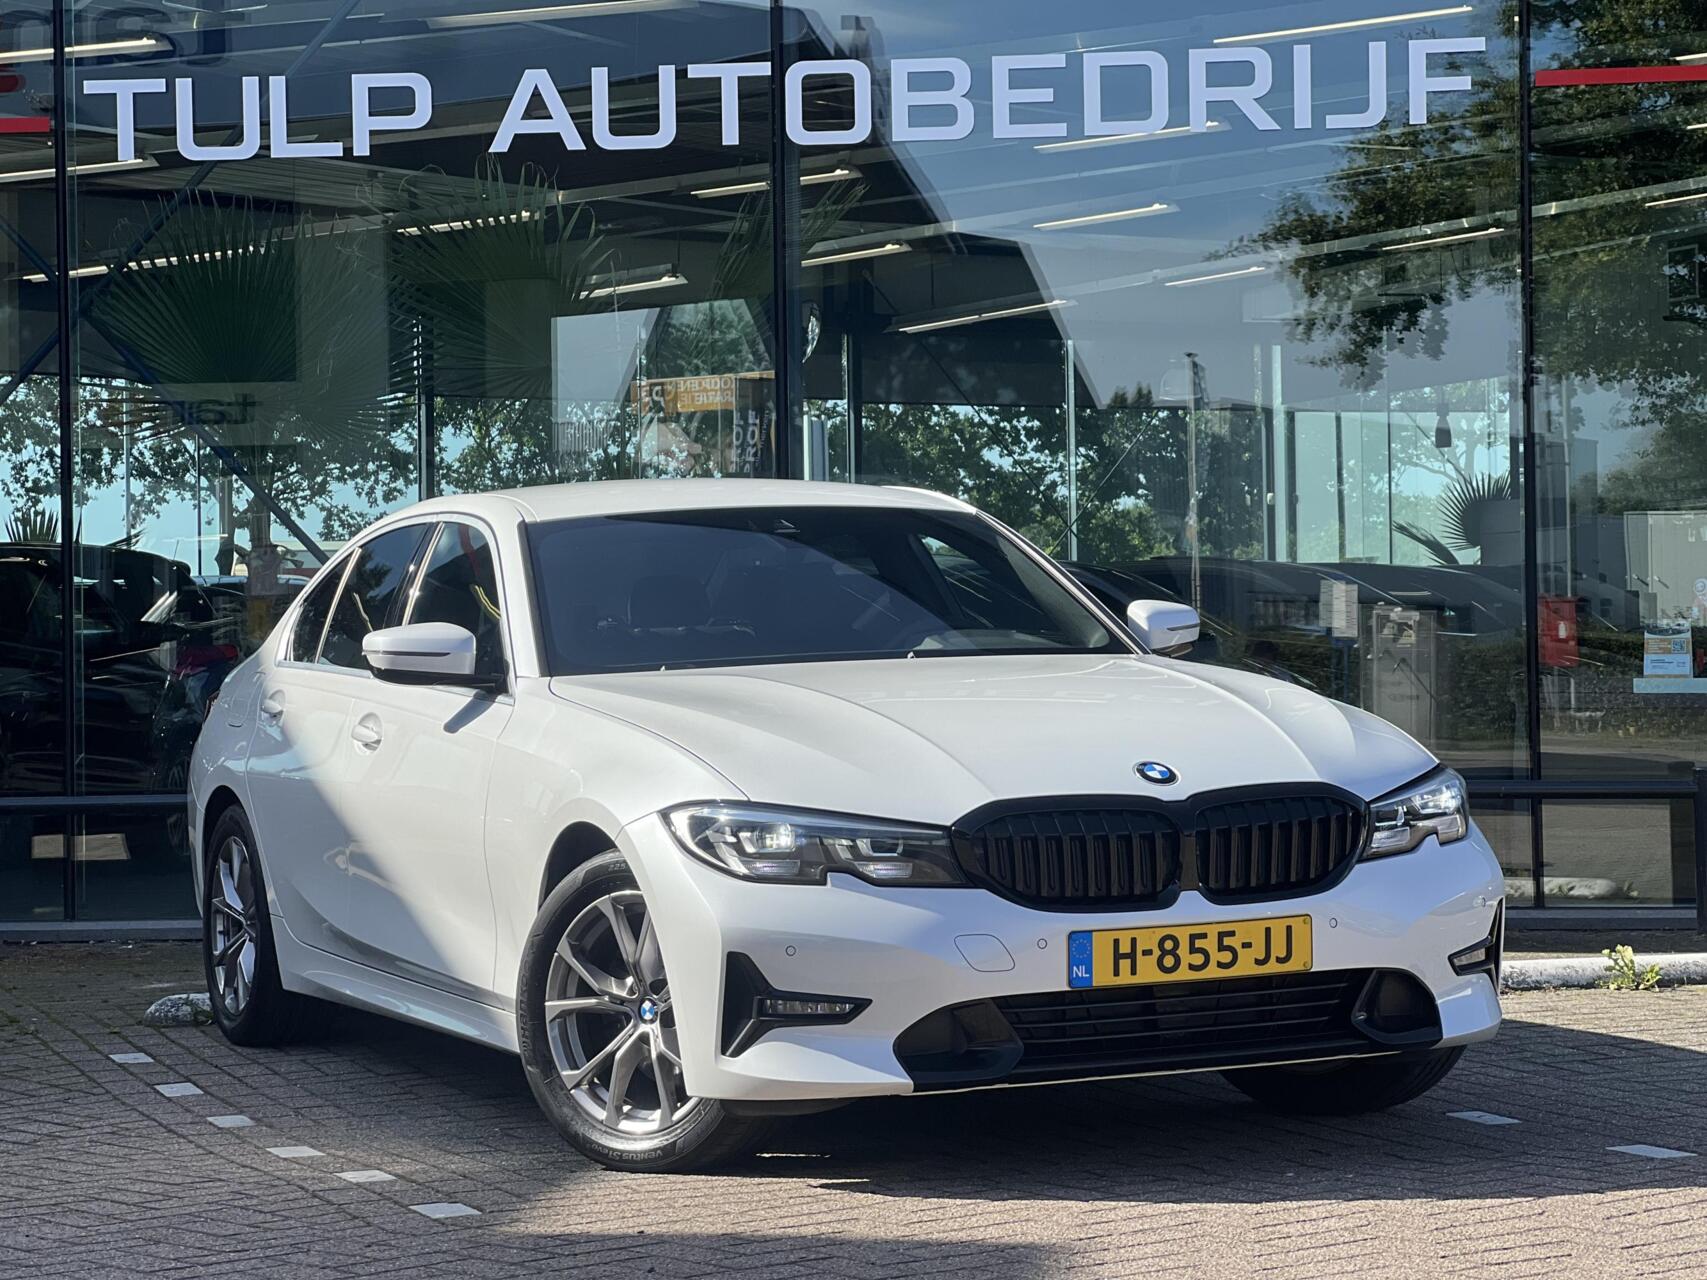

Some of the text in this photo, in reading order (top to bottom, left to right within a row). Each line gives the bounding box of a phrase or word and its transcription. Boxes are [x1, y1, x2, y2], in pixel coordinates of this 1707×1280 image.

[83, 37, 1486, 161] TULP AUTOBEDRIJF
[1072, 966, 1090, 978] NL
[1113, 925, 1293, 977] H-855-JJ
